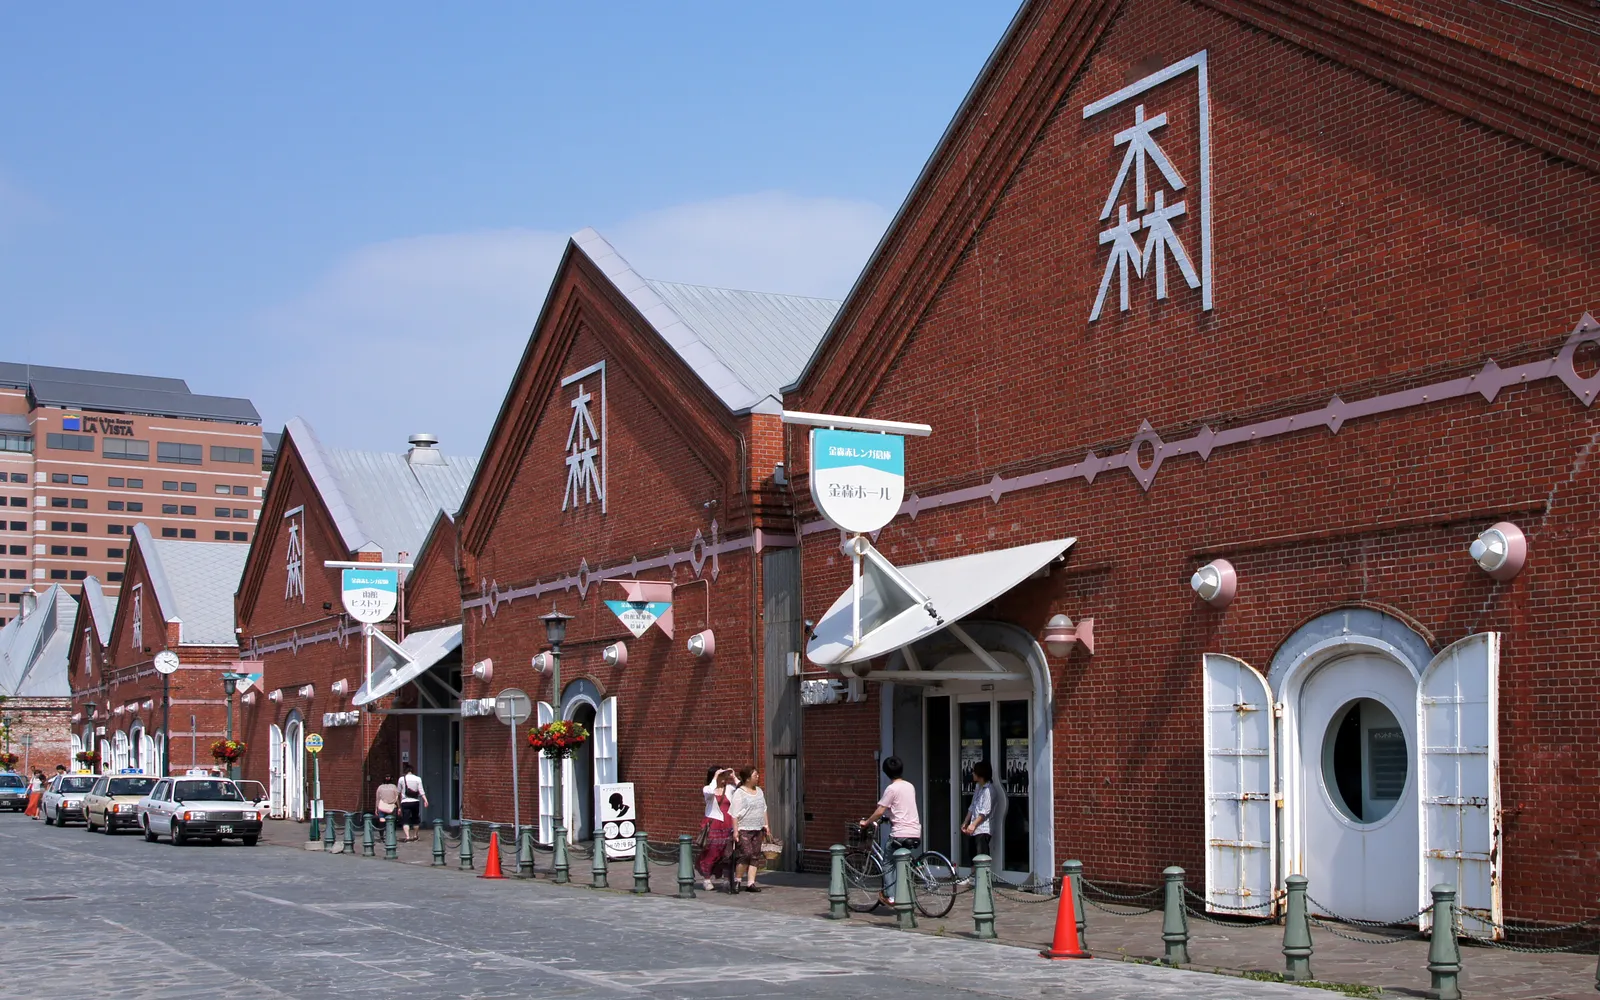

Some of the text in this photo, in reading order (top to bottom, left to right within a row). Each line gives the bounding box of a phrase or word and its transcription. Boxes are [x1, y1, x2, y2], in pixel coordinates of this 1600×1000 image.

[828, 482, 892, 501] 金森ホール
